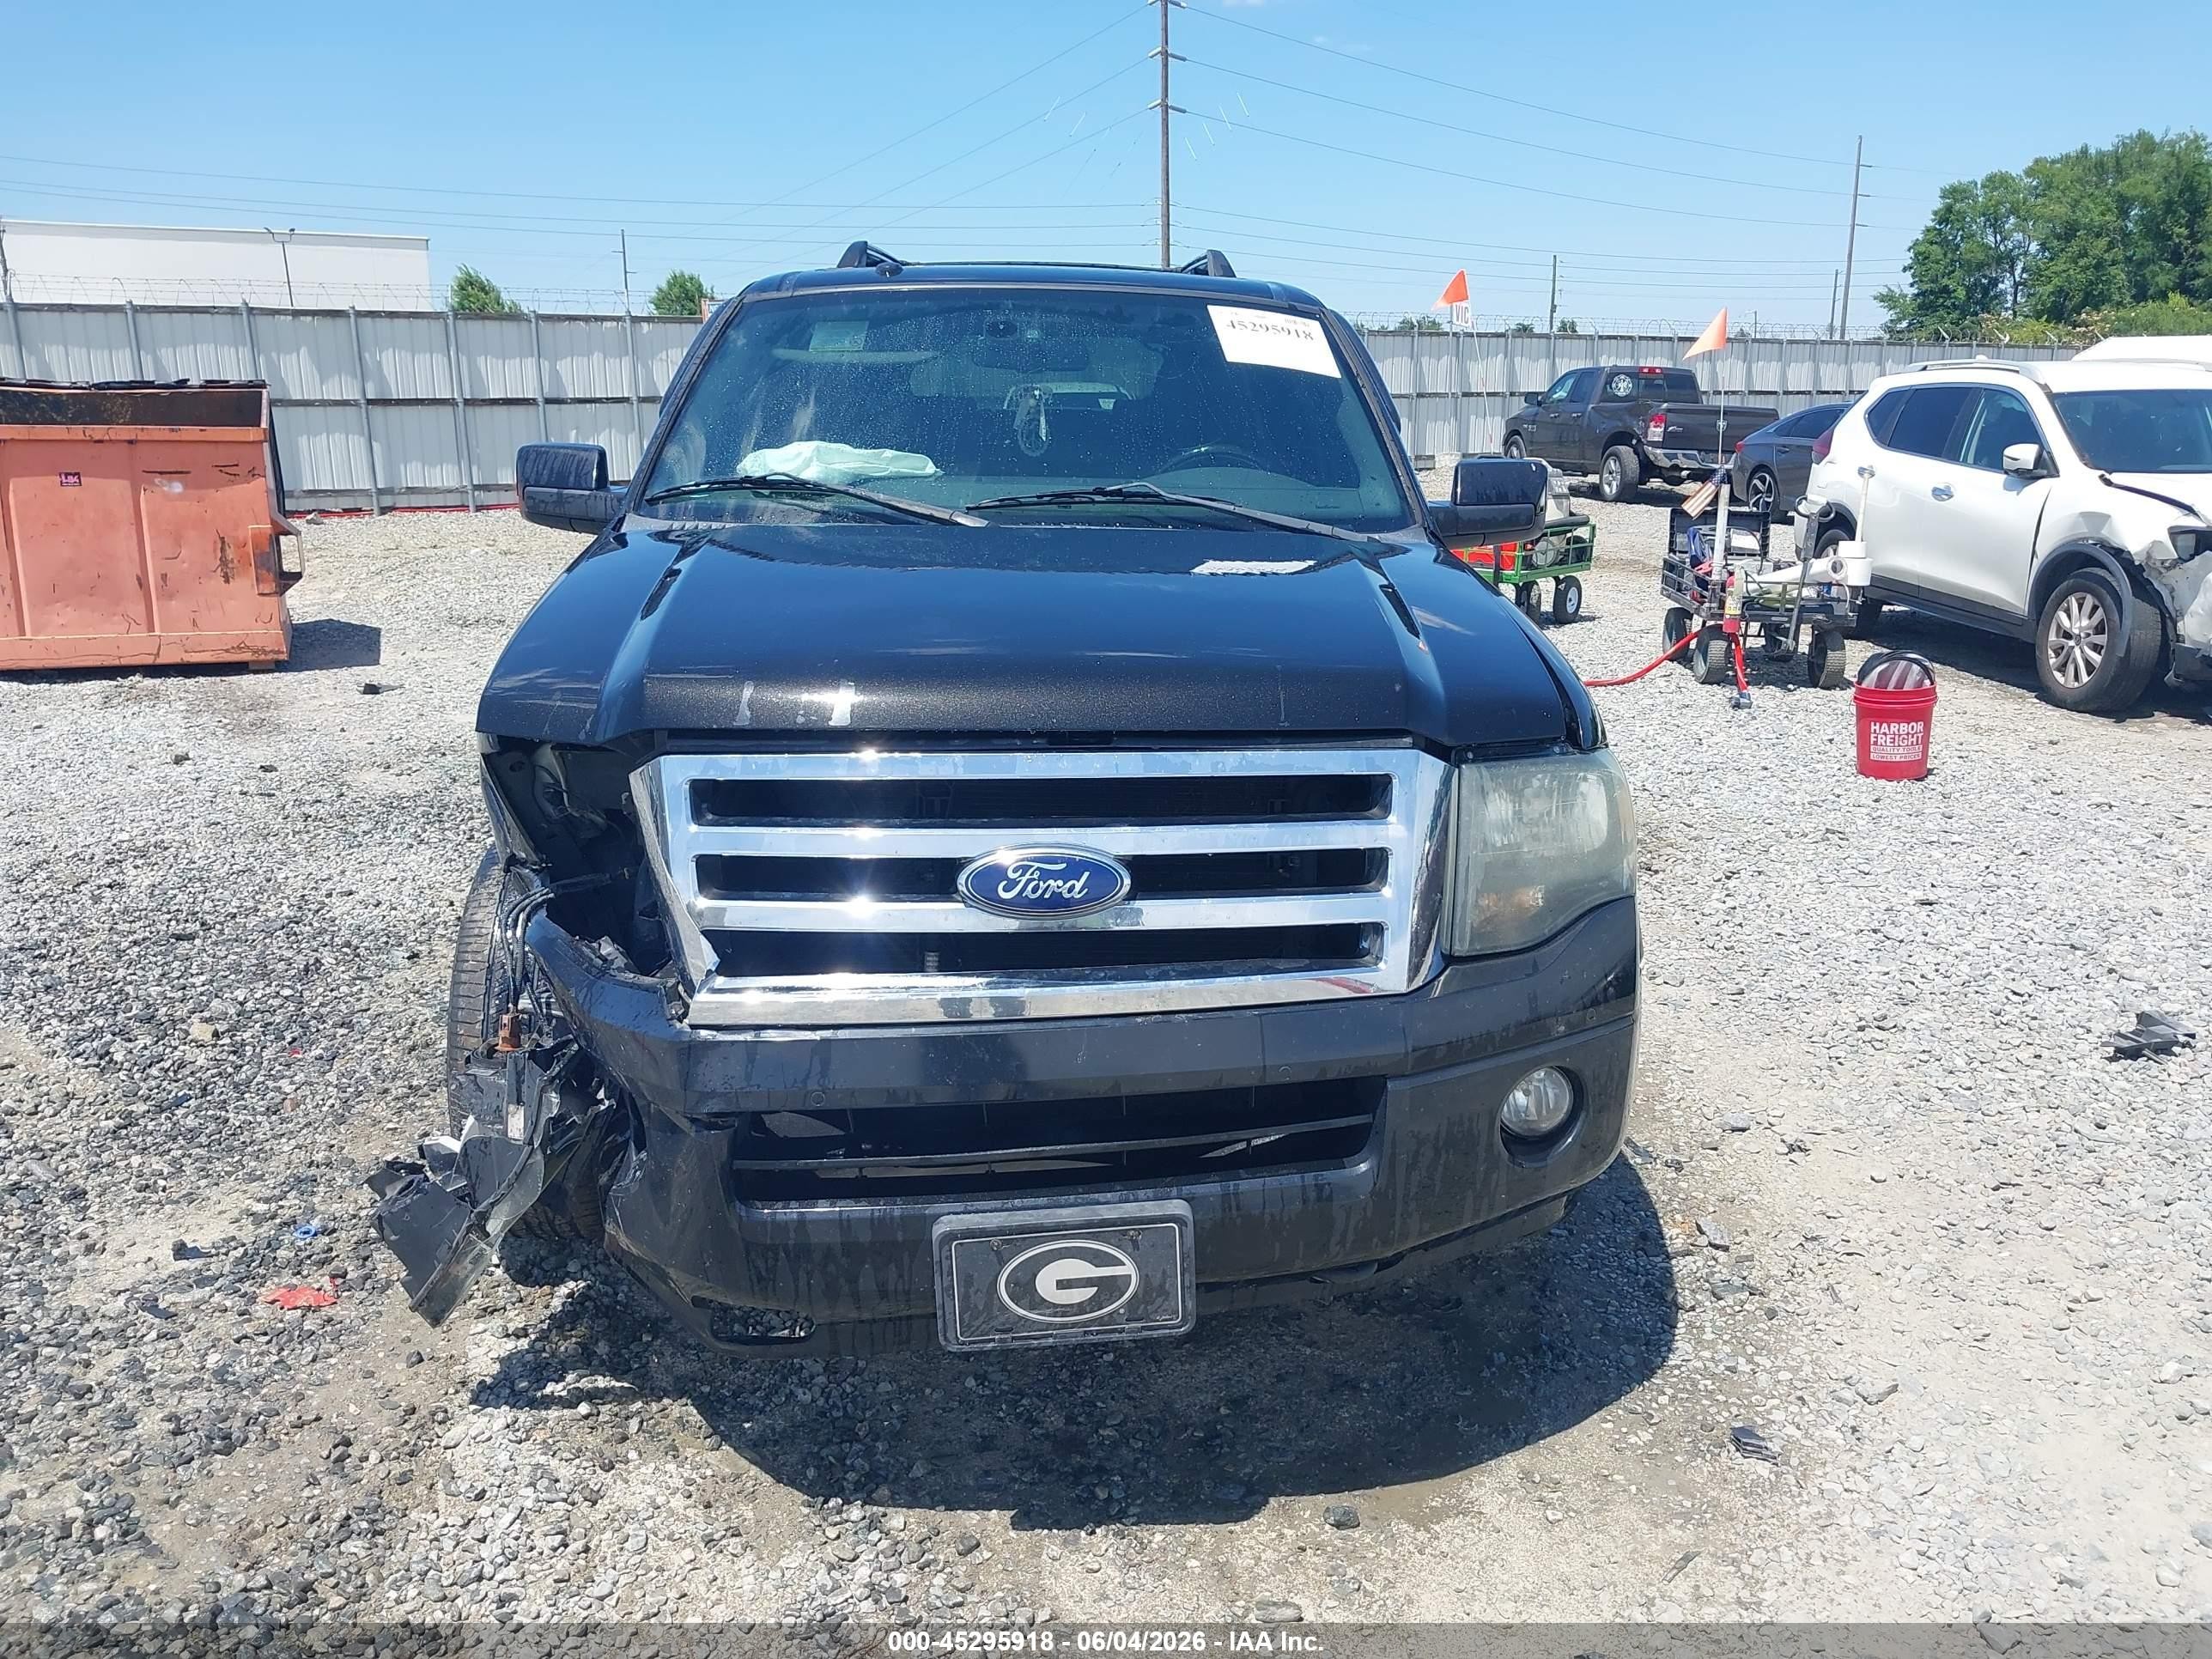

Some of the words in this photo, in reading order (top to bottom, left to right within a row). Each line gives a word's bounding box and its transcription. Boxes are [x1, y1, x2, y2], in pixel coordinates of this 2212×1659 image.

[1870, 721, 1924, 734] HARBOR
[1870, 733, 1923, 746] FREIGHT
[997, 860, 1091, 900] Ford
